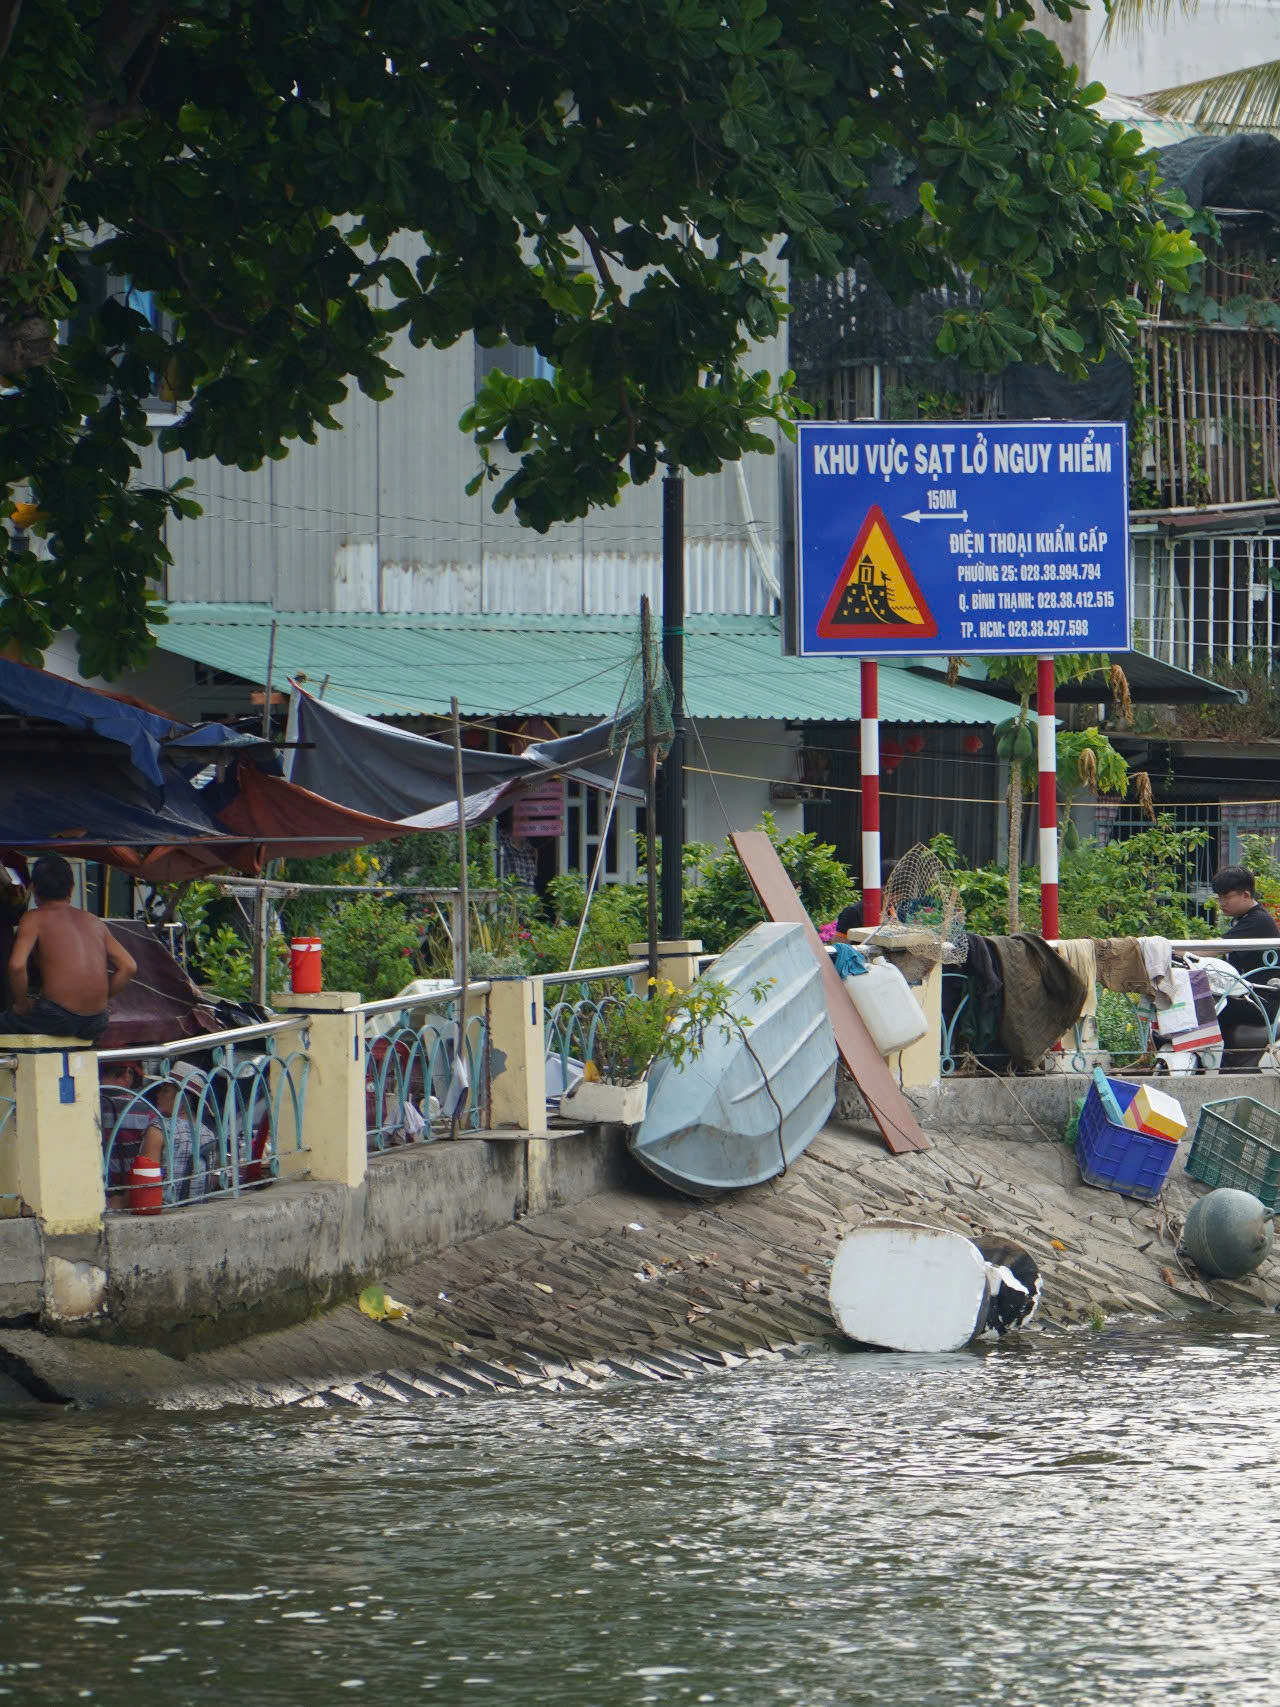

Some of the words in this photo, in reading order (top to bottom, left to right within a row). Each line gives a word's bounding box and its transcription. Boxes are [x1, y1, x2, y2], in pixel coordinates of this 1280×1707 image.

[814, 444, 859, 475] KHU
[865, 438, 909, 482] VỰC
[914, 443, 955, 482] SẠT
[961, 432, 988, 474] LỞ
[994, 443, 1052, 474] NGUY
[1059, 429, 1112, 473] HIỂM
[927, 489, 956, 510] 150M
[949, 529, 984, 558] ĐIỆN
[989, 532, 1032, 558] THOẠI
[1036, 523, 1074, 553] KHẨN
[1079, 526, 1108, 553] CẤP
[957, 561, 999, 582] PHƯỜNG
[1001, 565, 1018, 582] 25:
[1020, 563, 1101, 582] 028.38.994.794
[958, 593, 969, 612] Q.
[972, 589, 995, 610] BÌNH
[998, 592, 1035, 612] THẠNH:
[1037, 591, 1115, 609] 028.38.412.515
[960, 621, 977, 638] TP.
[979, 621, 1006, 638] HCM:
[1008, 619, 1089, 637] 028.38.297.598
